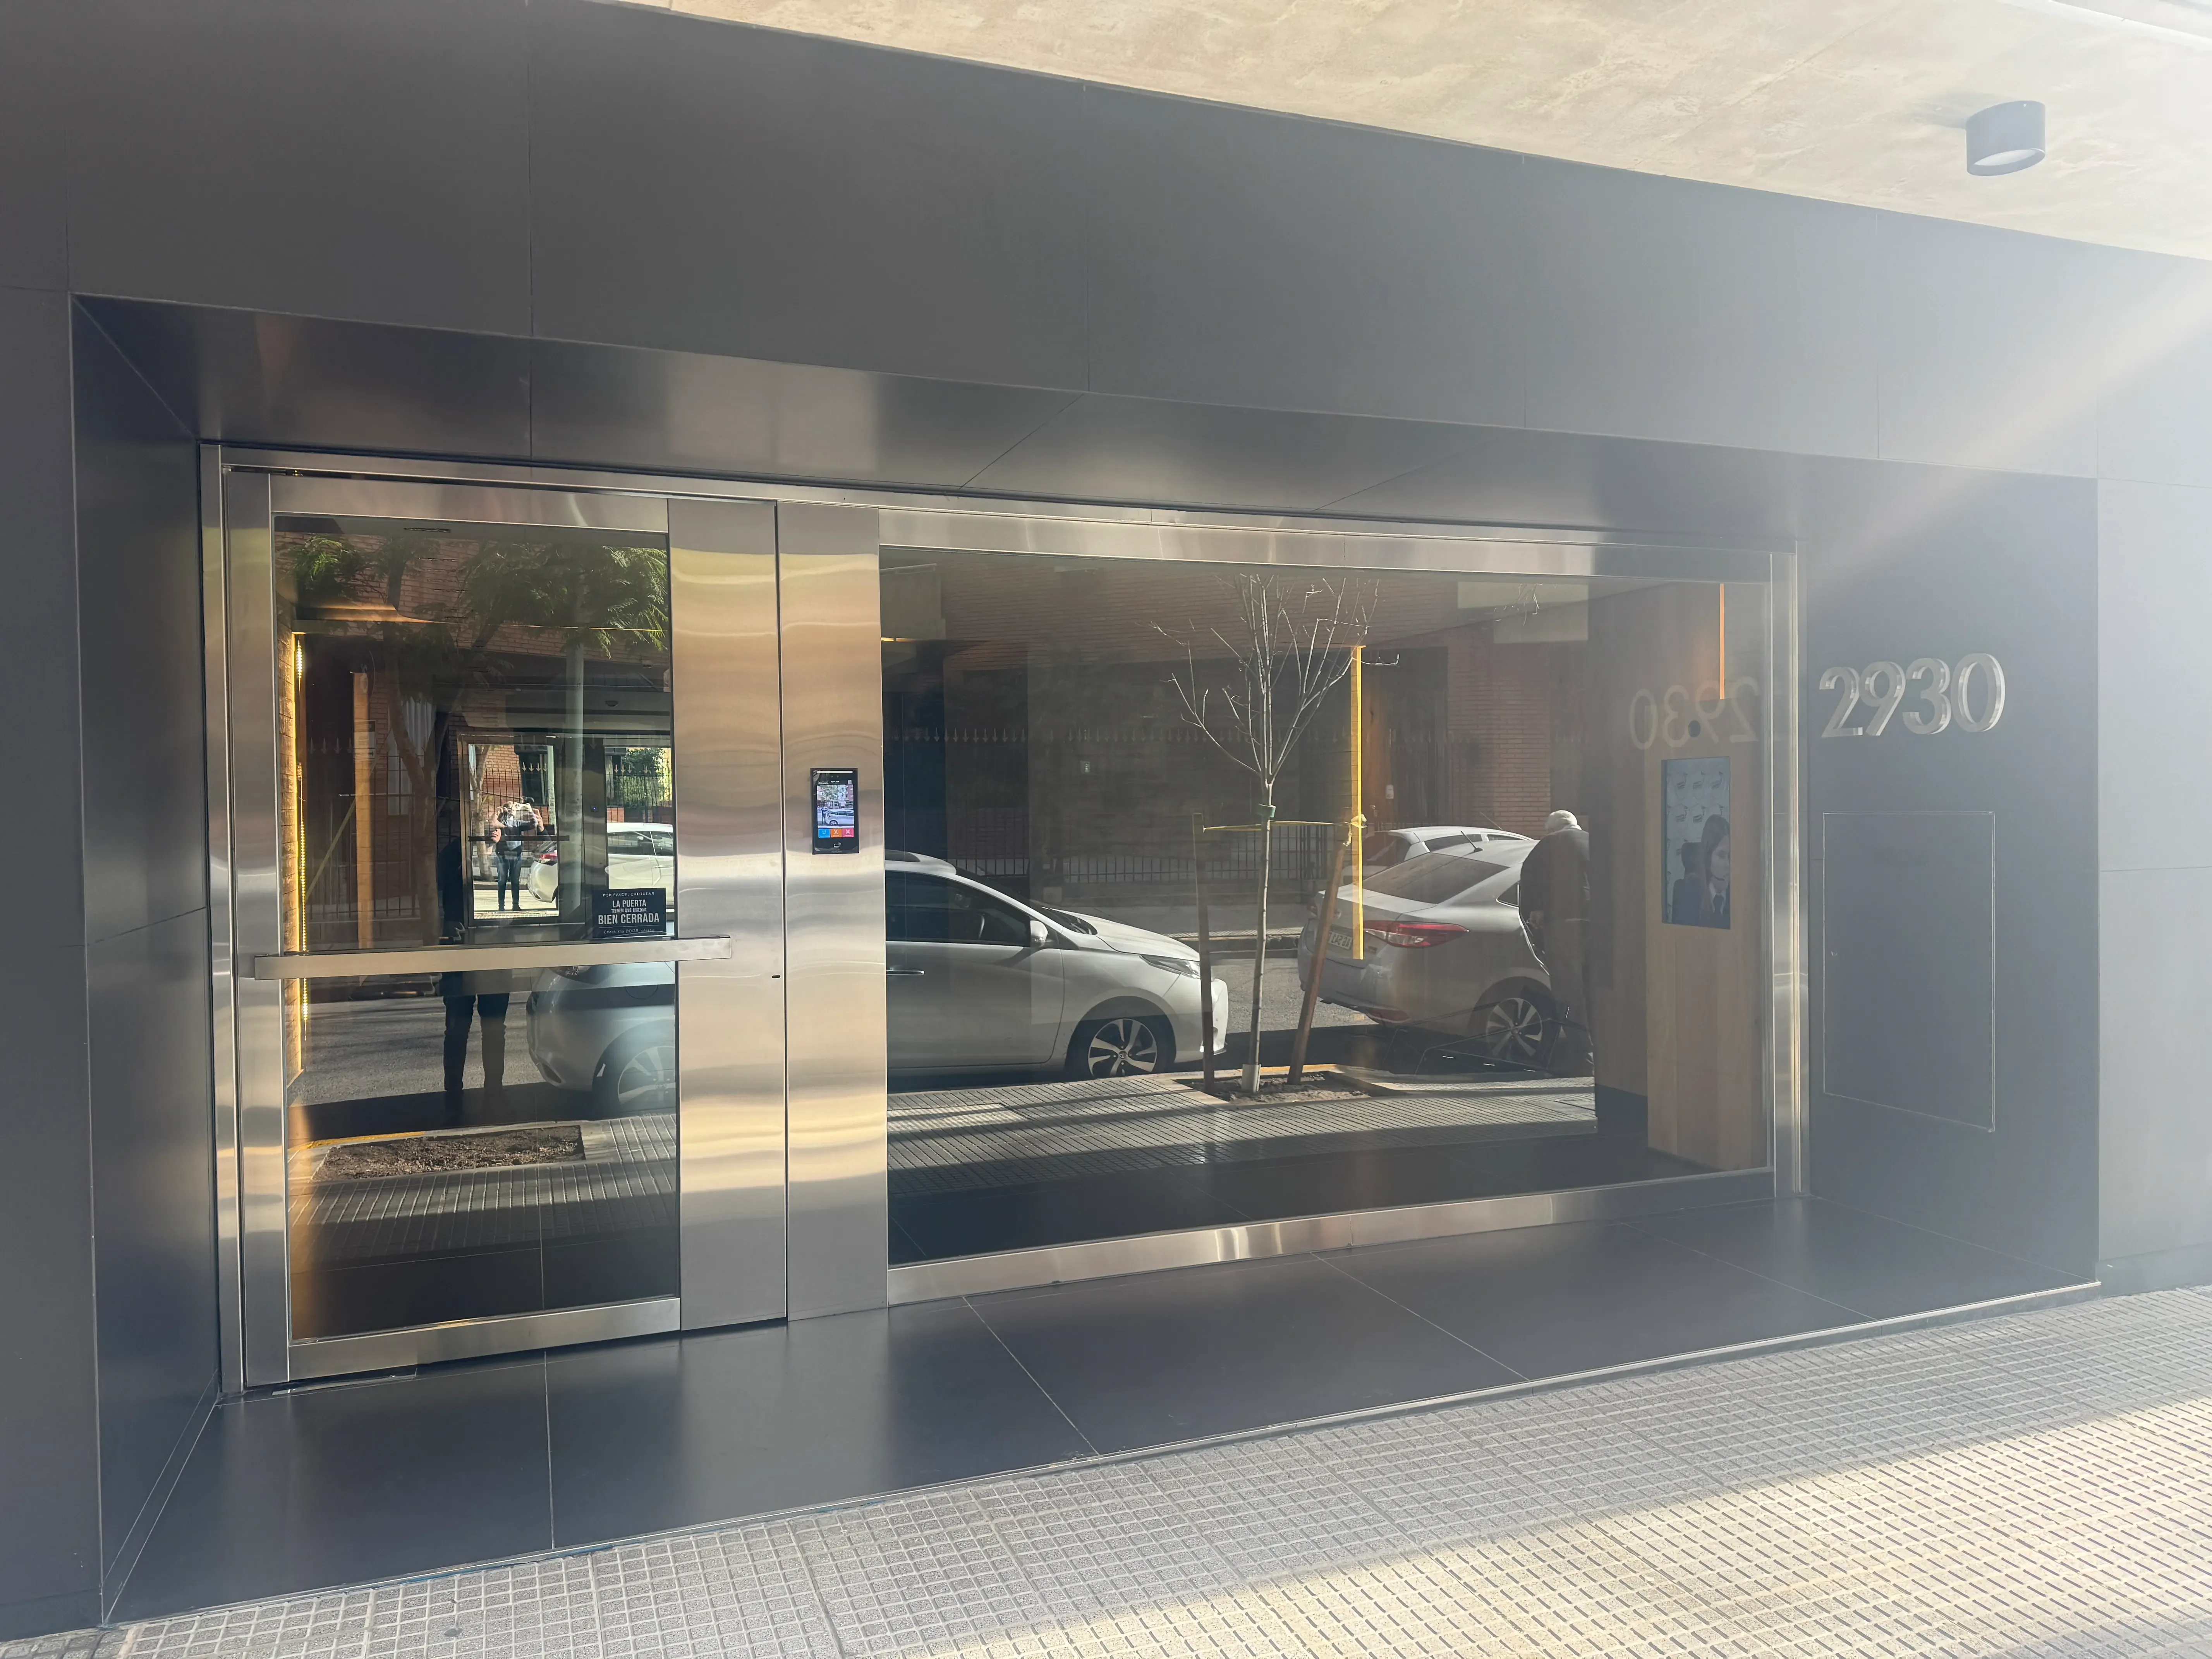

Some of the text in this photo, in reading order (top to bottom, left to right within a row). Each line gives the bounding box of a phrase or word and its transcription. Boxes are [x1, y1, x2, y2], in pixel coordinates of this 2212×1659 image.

[1819, 653, 2005, 737] 2930
[622, 899, 646, 907] PUERTA
[598, 913, 659, 924] BIEN CERRADA
